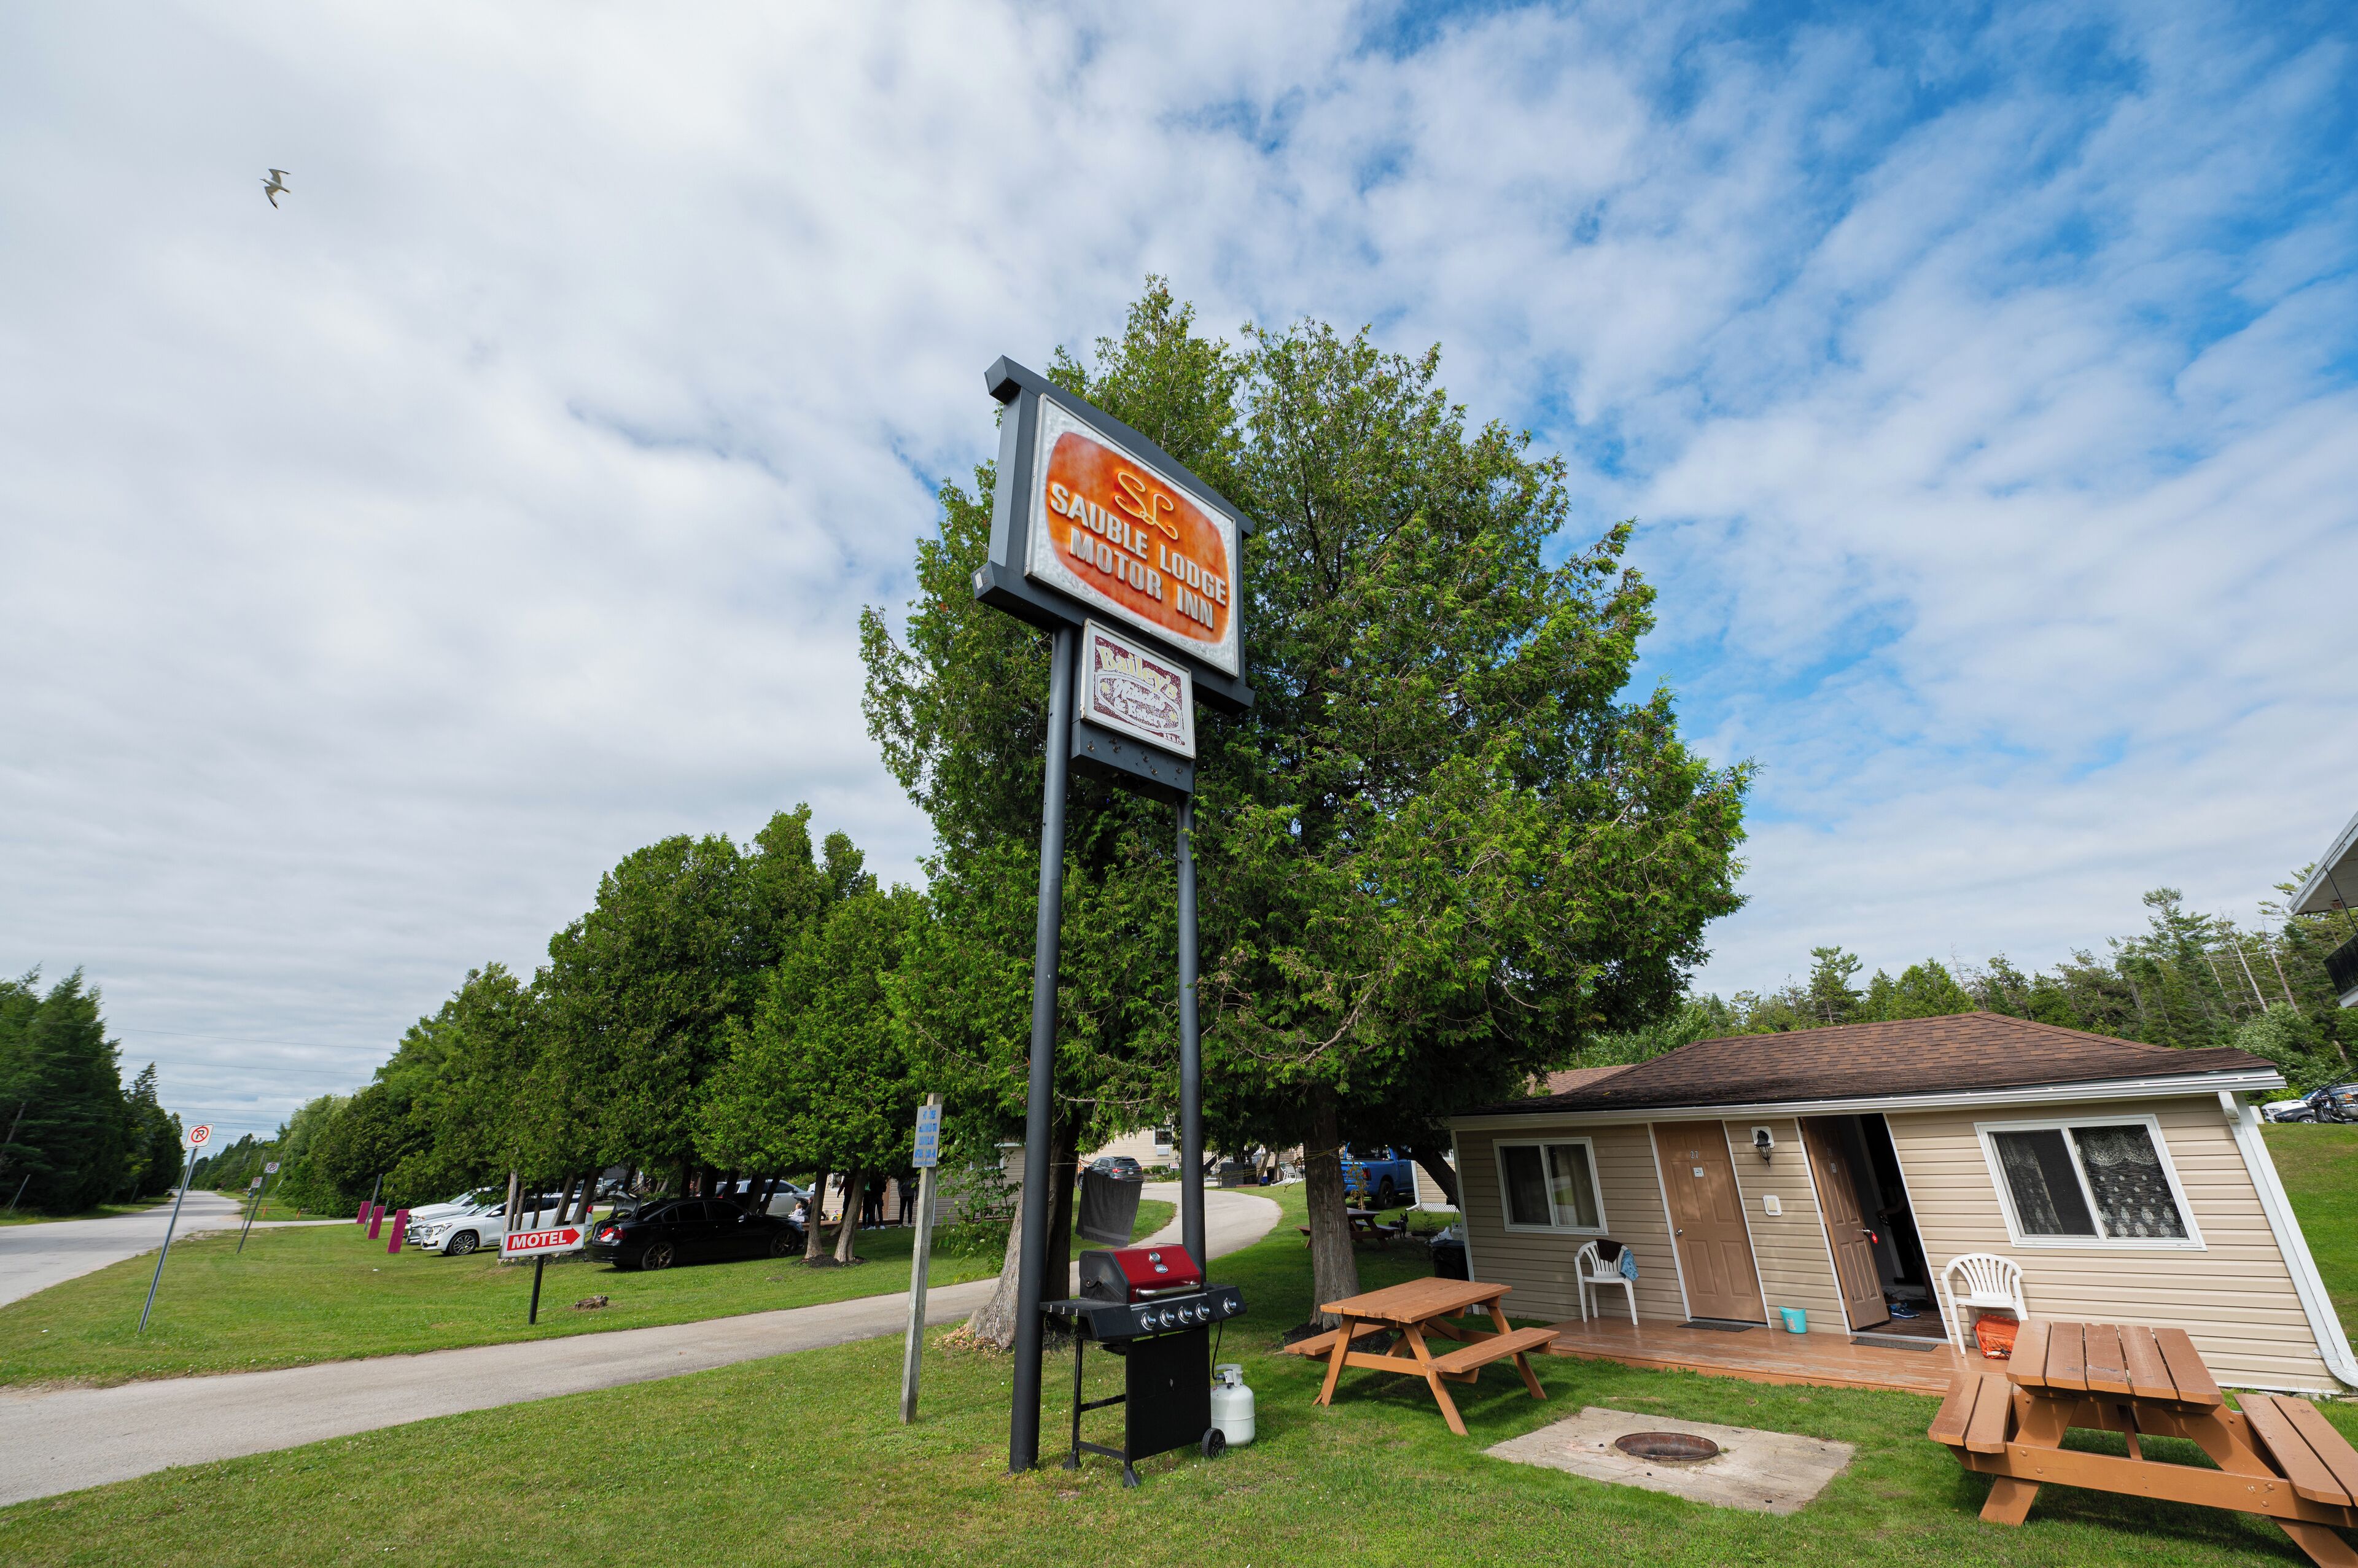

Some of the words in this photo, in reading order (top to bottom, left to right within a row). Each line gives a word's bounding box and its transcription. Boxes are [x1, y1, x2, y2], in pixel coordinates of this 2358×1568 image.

[1051, 483, 1148, 560] SAUBLE
[1160, 543, 1226, 606] LODGE
[1070, 527, 1162, 601] MOTOR
[1177, 584, 1213, 629] INN
[1097, 645, 1178, 699] Bailey's
[1690, 1151, 1698, 1159] 27
[512, 1231, 567, 1249] MOTEL
